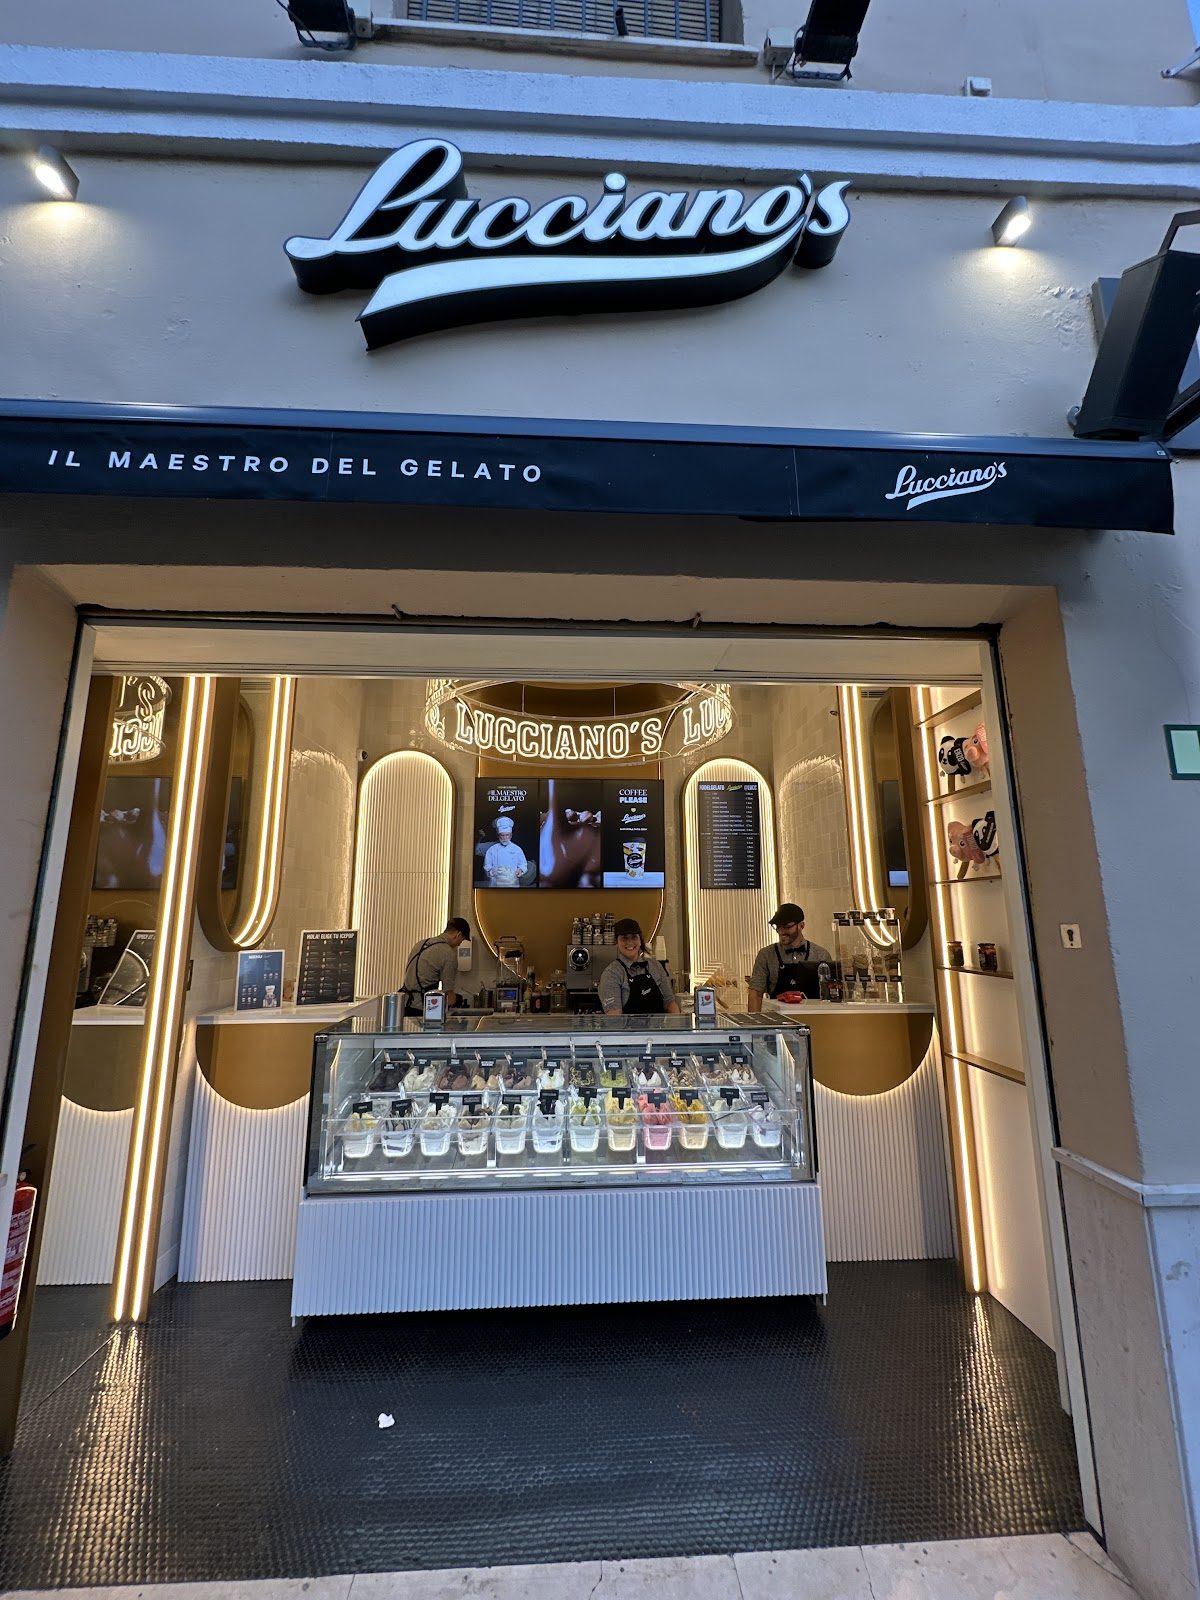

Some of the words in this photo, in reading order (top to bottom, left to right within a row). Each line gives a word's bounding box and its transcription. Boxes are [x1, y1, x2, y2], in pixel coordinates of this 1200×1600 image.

[284, 137, 853, 322] Lucciano's
[48, 450, 80, 466] IL
[109, 452, 288, 472] MAESTRO
[312, 458, 376, 475] DEL
[401, 459, 542, 482] GELATO
[885, 462, 1007, 510] Lucciano's
[455, 702, 662, 760] LUCCIANO'S
[619, 796, 648, 804] PLEASE
